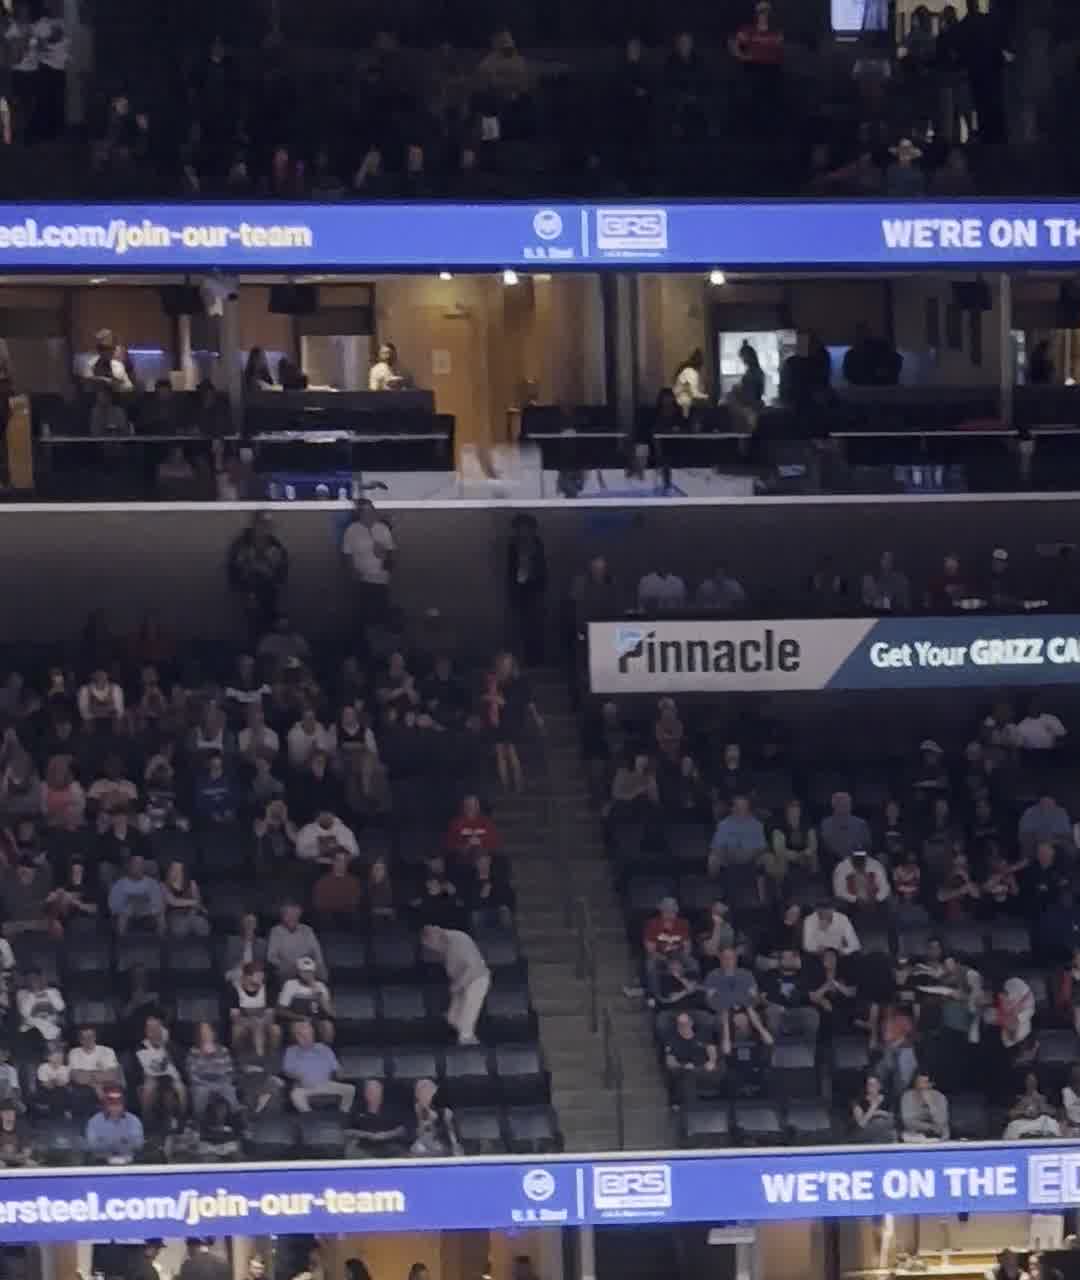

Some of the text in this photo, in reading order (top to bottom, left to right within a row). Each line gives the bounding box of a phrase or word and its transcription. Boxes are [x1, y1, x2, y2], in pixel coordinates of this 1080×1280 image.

[881, 218, 981, 249] WE'RE
[990, 219, 1038, 248] ON
[615, 625, 801, 674] Pinnacle
[869, 642, 913, 668] Get
[914, 641, 969, 667] Your
[969, 637, 1045, 665] GRIZZ
[600, 1172, 665, 1195] BRS
[761, 1169, 874, 1204] WE'RE
[881, 1169, 936, 1200] ON
[943, 1166, 1018, 1199] THE
